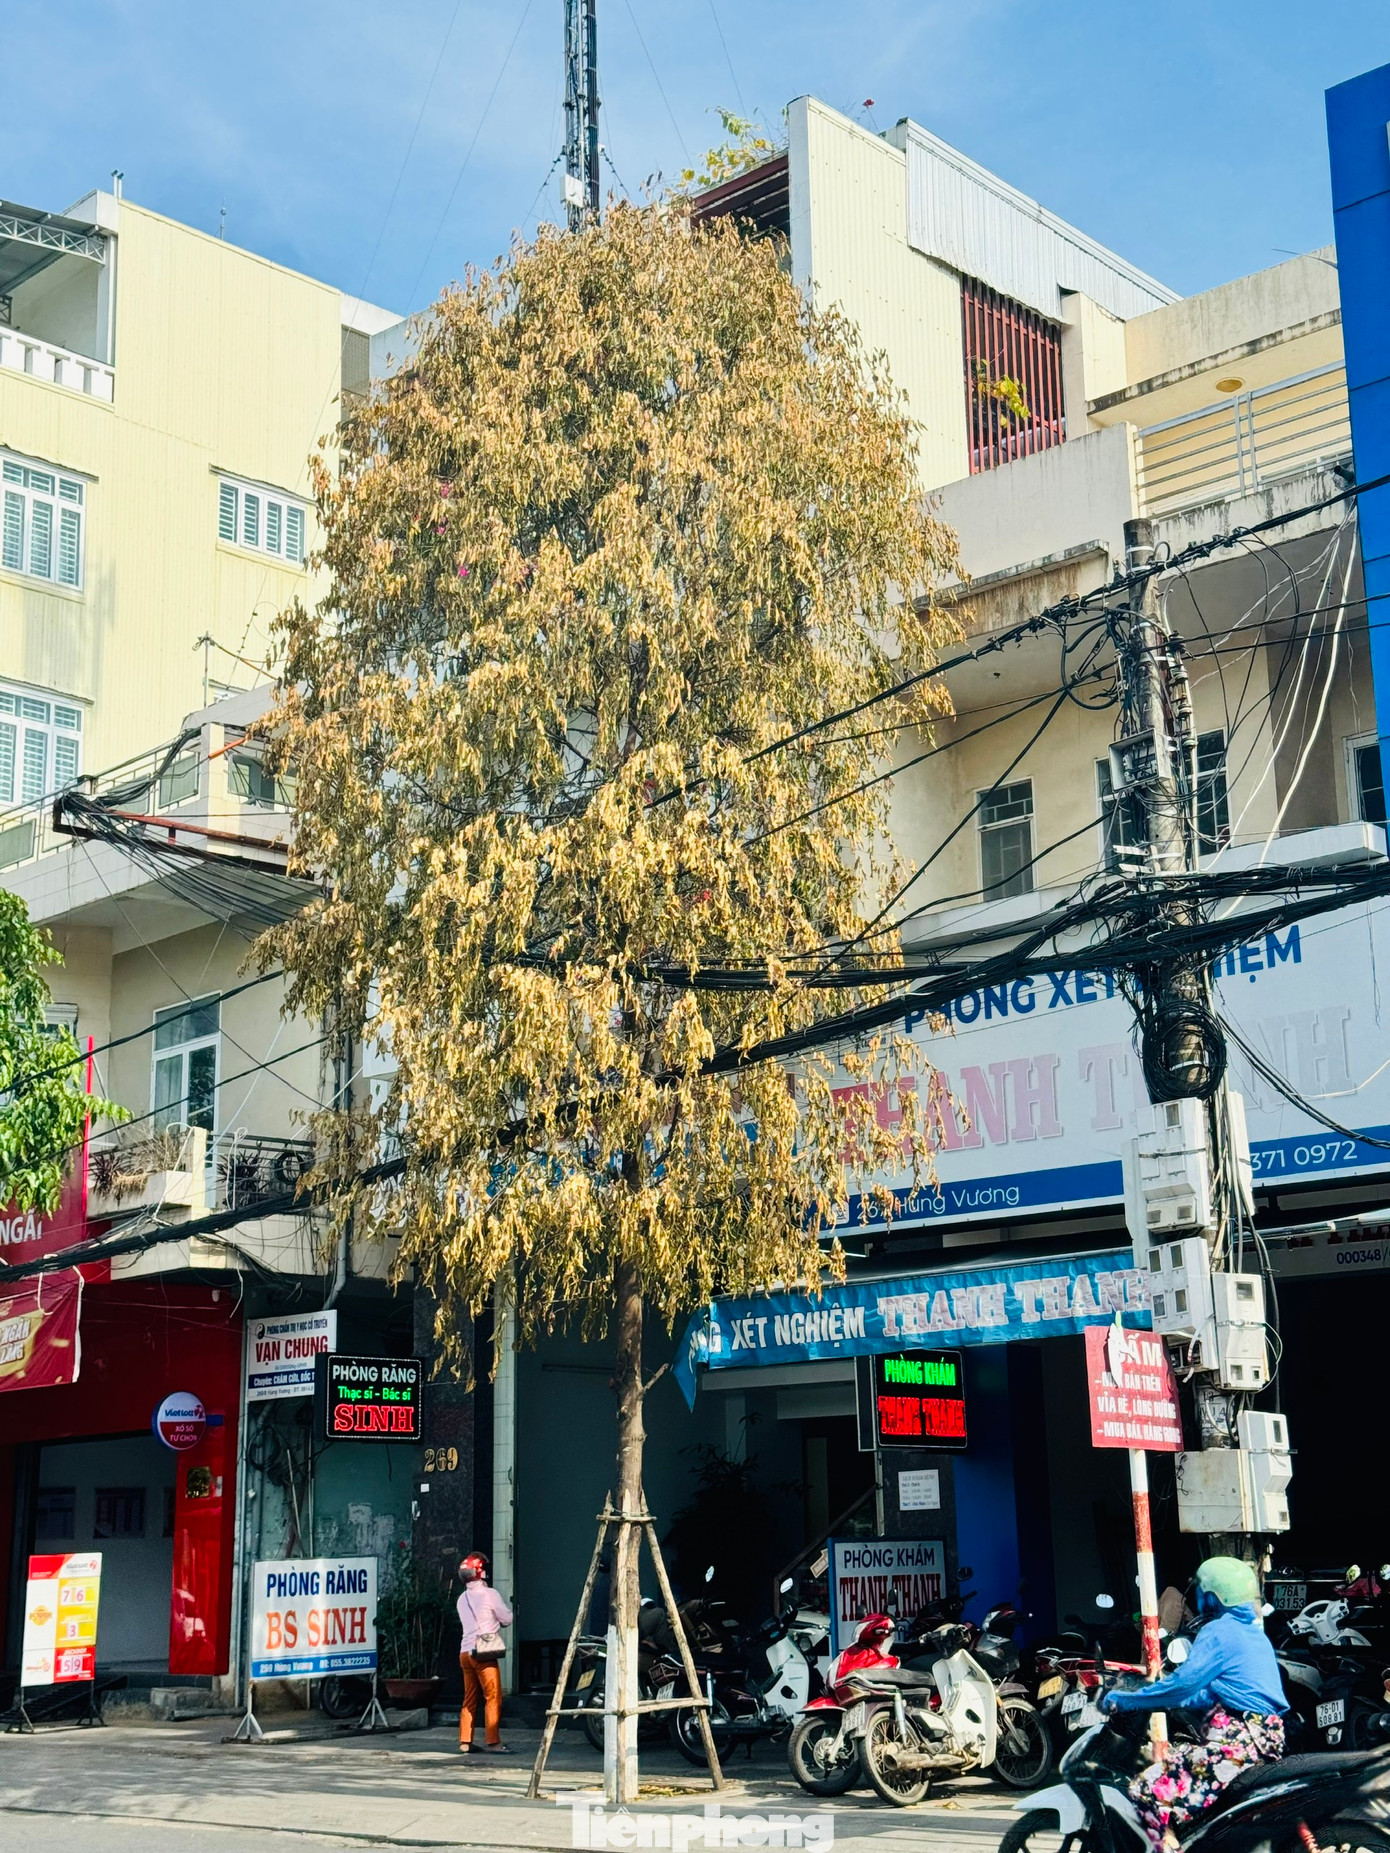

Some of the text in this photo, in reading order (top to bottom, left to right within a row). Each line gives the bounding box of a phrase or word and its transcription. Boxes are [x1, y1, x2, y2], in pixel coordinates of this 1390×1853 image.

[951, 1185, 1020, 1208] Vương
[1293, 1140, 1358, 1165] 0972
[732, 1312, 768, 1351] XÉT
[774, 1302, 867, 1348] NGHIỆM
[877, 1283, 1010, 1337] THANH
[256, 1335, 329, 1366] VẠN CHUNG
[332, 1360, 378, 1382] PHÒNG
[381, 1363, 417, 1384] RĂNG
[885, 1354, 956, 1386] PHÒNG KHÁM
[337, 1385, 362, 1401] Thạc
[382, 1387, 400, 1400] Bác
[334, 1404, 415, 1432] SINH
[424, 1447, 458, 1472] 269
[844, 1544, 894, 1568] PHÒNG
[897, 1543, 936, 1566] KHÁM
[266, 1563, 367, 1598] PHÒNG RĂNG
[1281, 1585, 1299, 1597] 76A
[840, 1573, 941, 1621] THANH THANH
[266, 1606, 367, 1649] BS SINH
